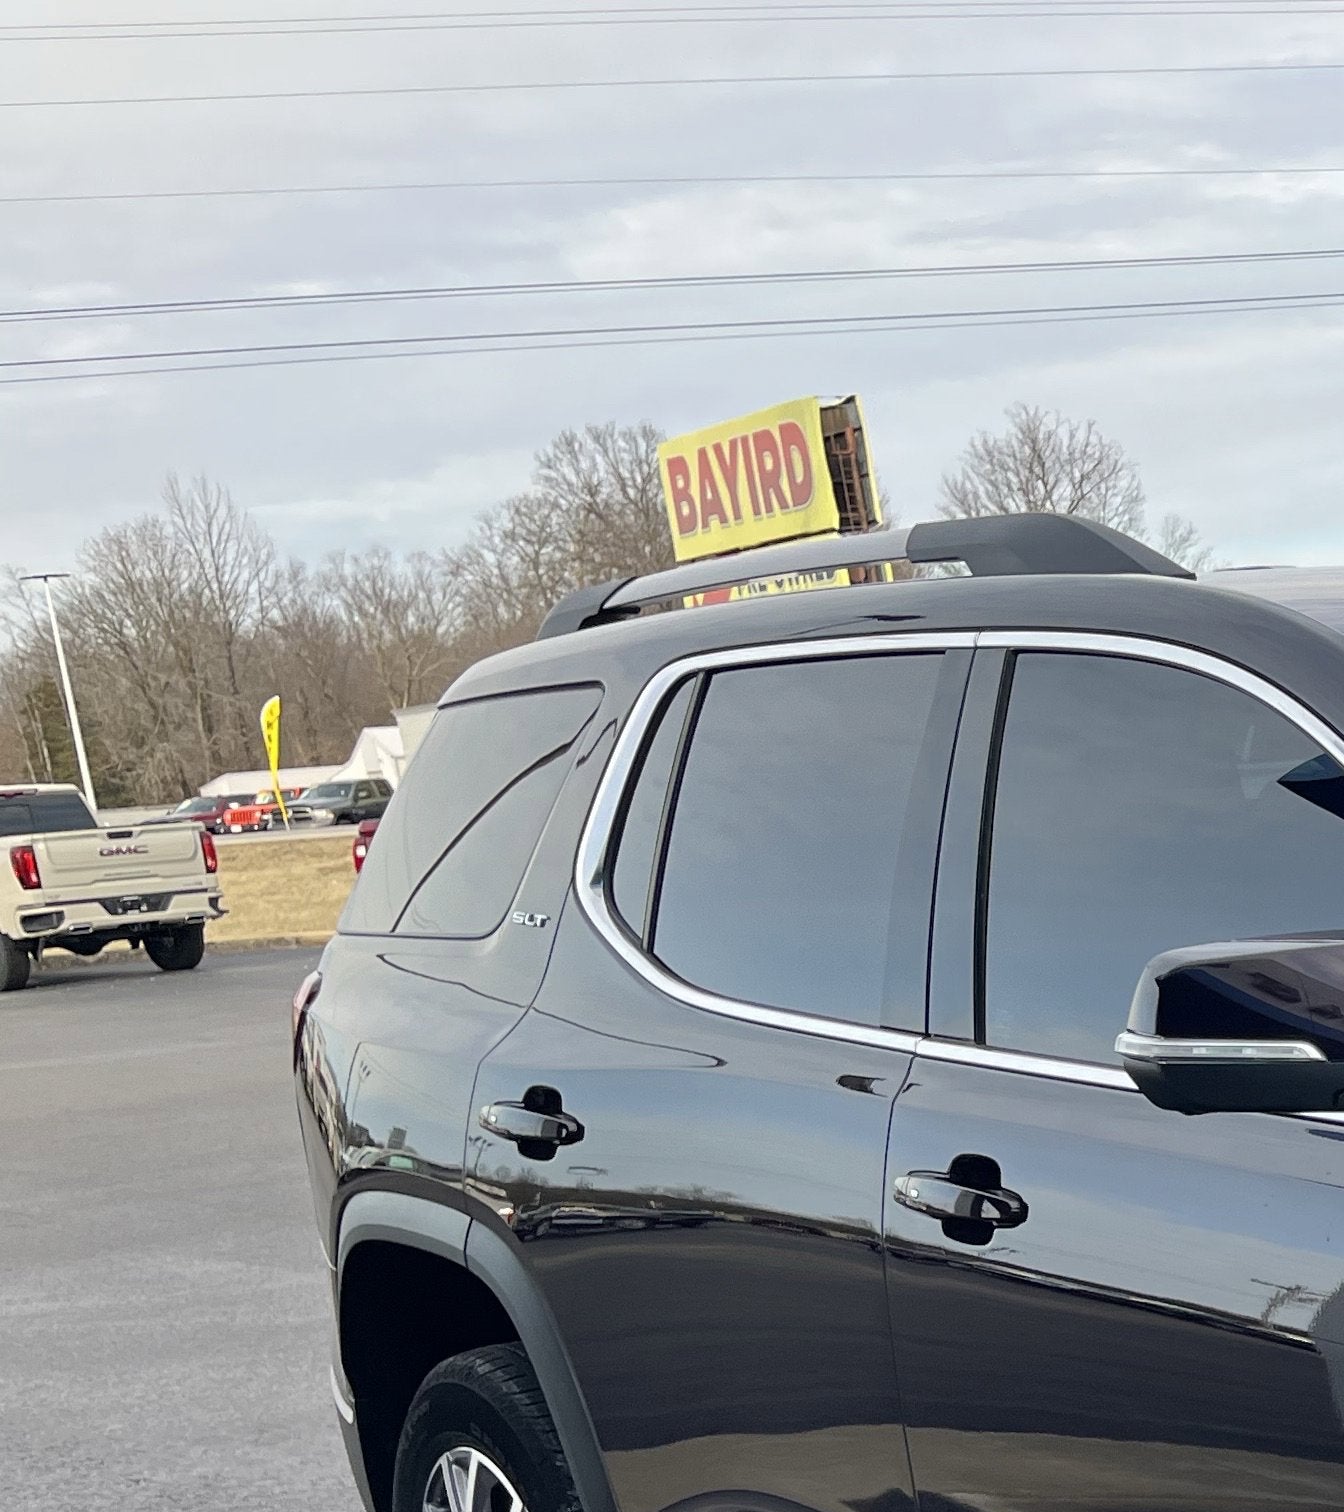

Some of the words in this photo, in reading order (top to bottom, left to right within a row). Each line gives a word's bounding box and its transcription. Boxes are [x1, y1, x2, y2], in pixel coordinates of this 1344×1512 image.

[666, 421, 815, 538] BAYIRD
[98, 845, 149, 857] GMC
[512, 911, 550, 928] SLT
